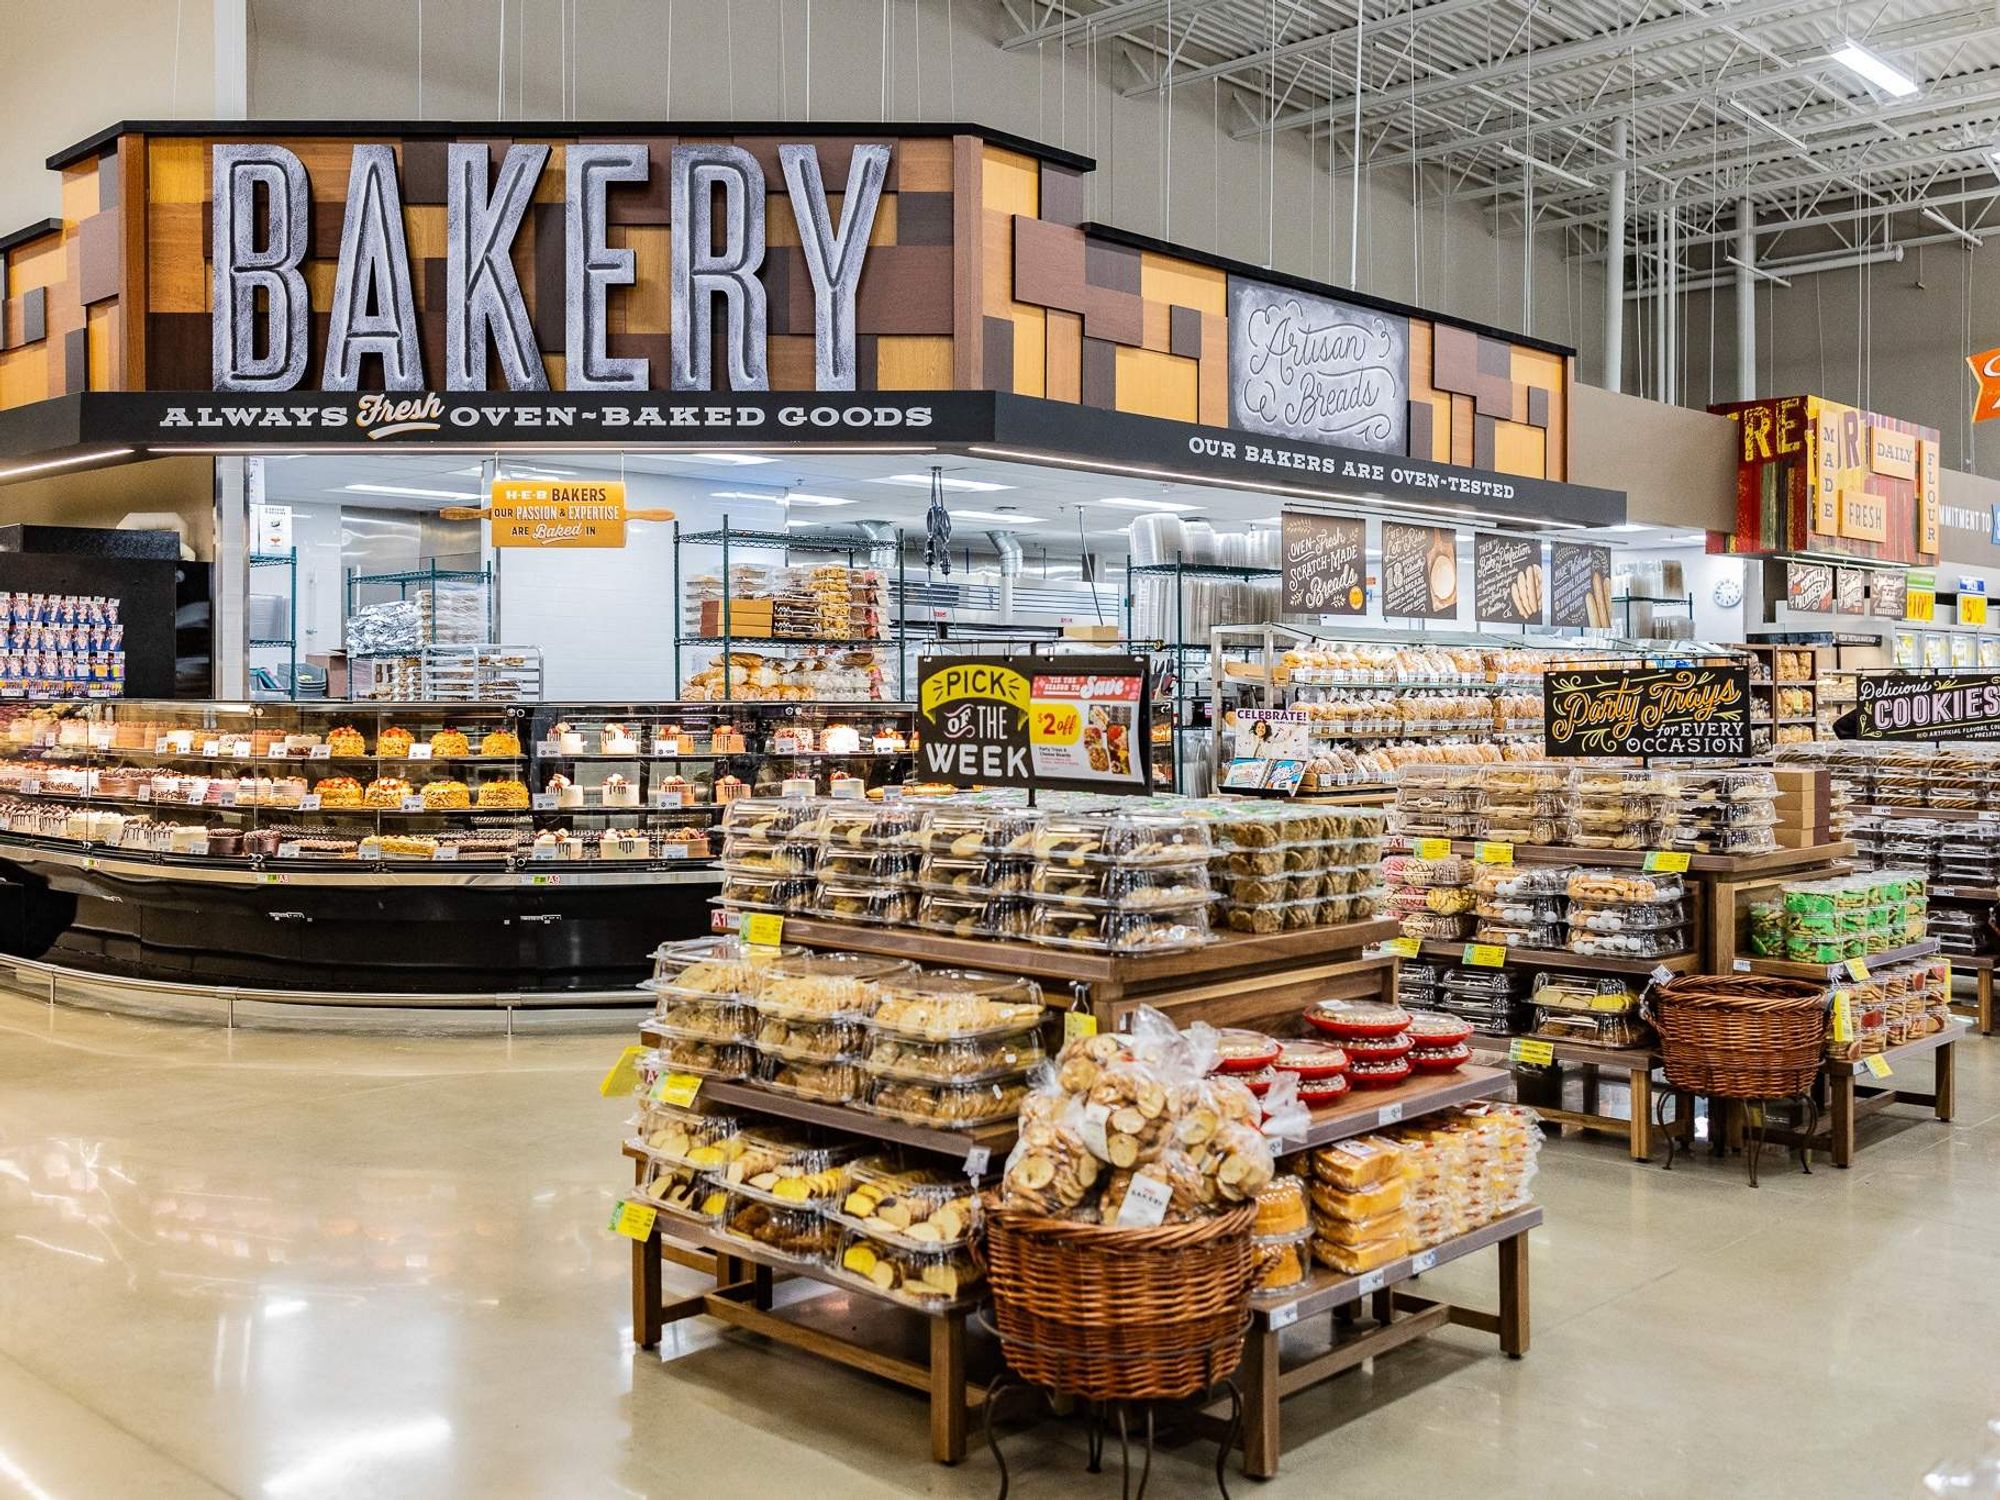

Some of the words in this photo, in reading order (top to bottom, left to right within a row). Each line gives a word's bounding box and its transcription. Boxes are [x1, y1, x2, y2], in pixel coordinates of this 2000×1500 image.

[211, 142, 893, 394] BAKERY
[1249, 316, 1368, 378] Artisan
[158, 406, 349, 428] ALWAYS
[355, 392, 445, 430] Fresh
[777, 405, 934, 428] GOODS
[1284, 367, 1381, 426] Breads
[1188, 435, 1237, 459] OUR
[1244, 444, 1336, 474] BAKERS
[1341, 460, 1385, 481] ARE
[1876, 441, 1914, 464] DAILY
[1822, 426, 1836, 519] MADE
[551, 487, 607, 502] BAKERS
[1926, 452, 1936, 541] FLOUR
[494, 507, 513, 519] OUR
[516, 505, 557, 521] PASSION
[559, 509, 566, 519] &
[568, 504, 619, 521] EXPERTISE
[1848, 501, 1883, 530] FRESH
[1981, 511, 1991, 534] TO
[511, 526, 529, 536] ARE
[532, 522, 583, 541] Baked
[585, 526, 596, 536] IN
[1305, 563, 1359, 609] Breads
[1385, 561, 1404, 594] 18
[946, 670, 1007, 697] PICK
[1080, 675, 1125, 699] Save
[1859, 679, 1933, 702] Delicious
[947, 709, 971, 732] OF
[976, 705, 1008, 740] THE
[1237, 709, 1307, 721] CELEBRATE!
[1552, 677, 1644, 743] Party
[1640, 671, 1742, 732] Trays
[1874, 685, 2000, 730] COOKIES
[1057, 713, 1077, 736] off
[1655, 722, 1682, 739] for
[1681, 722, 1745, 737] EVERY
[925, 742, 1030, 778] WEEK
[1625, 737, 1745, 753] OCCASION
